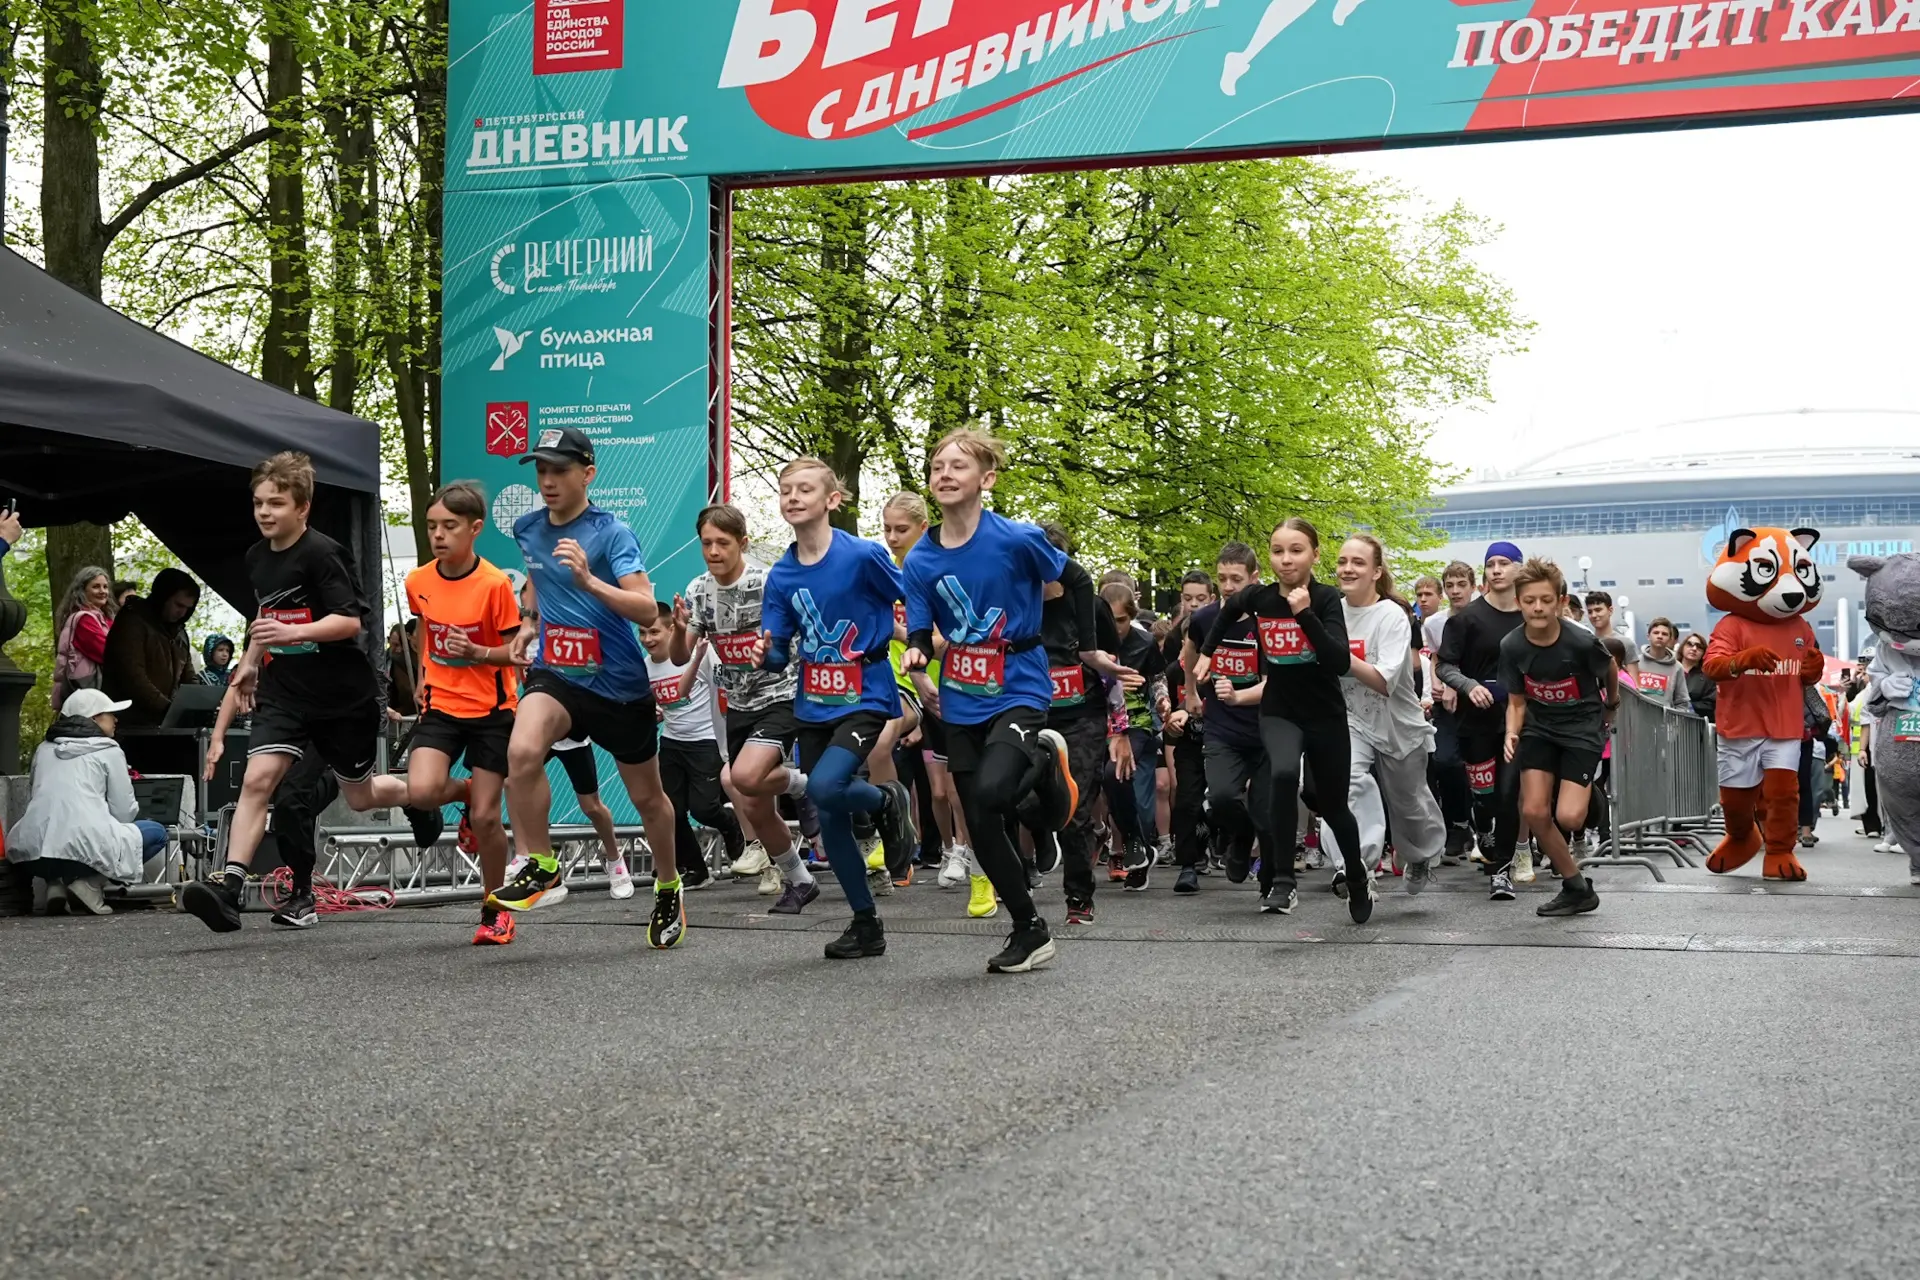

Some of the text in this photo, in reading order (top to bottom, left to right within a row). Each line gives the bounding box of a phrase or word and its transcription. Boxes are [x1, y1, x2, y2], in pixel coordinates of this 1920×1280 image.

[547, 8, 570, 19] ГОД
[547, 16, 609, 31] ЕДИНСТВА
[546, 28, 602, 41] НАРОДОВ
[1447, 0, 1773, 68] ПОБЕДИТ
[546, 39, 595, 52] РОССИИ
[485, 109, 585, 127] ПЕТЕРБУРГСКИЙ
[807, 89, 842, 139] С
[466, 115, 688, 168] ДНЕВНИК
[525, 230, 653, 279] ВЕЧЕРНИЙ
[540, 327, 653, 350] бумажная
[540, 352, 605, 370] птица
[539, 403, 631, 415] КОМИТЕТ ПО ПЕЧАТИ
[547, 414, 634, 425] ВЗАИМОДЕЙСТВИЮ
[592, 496, 647, 508] ИЗИЧЕСКОЙ
[1264, 631, 1300, 649] 654
[552, 638, 584, 661] 671
[724, 645, 752, 659] 660
[952, 653, 987, 678] 589
[1216, 656, 1246, 673] 598
[810, 668, 846, 691] 588
[655, 685, 678, 700] 695
[1533, 687, 1566, 700] 680
[1470, 771, 1493, 785] 590
